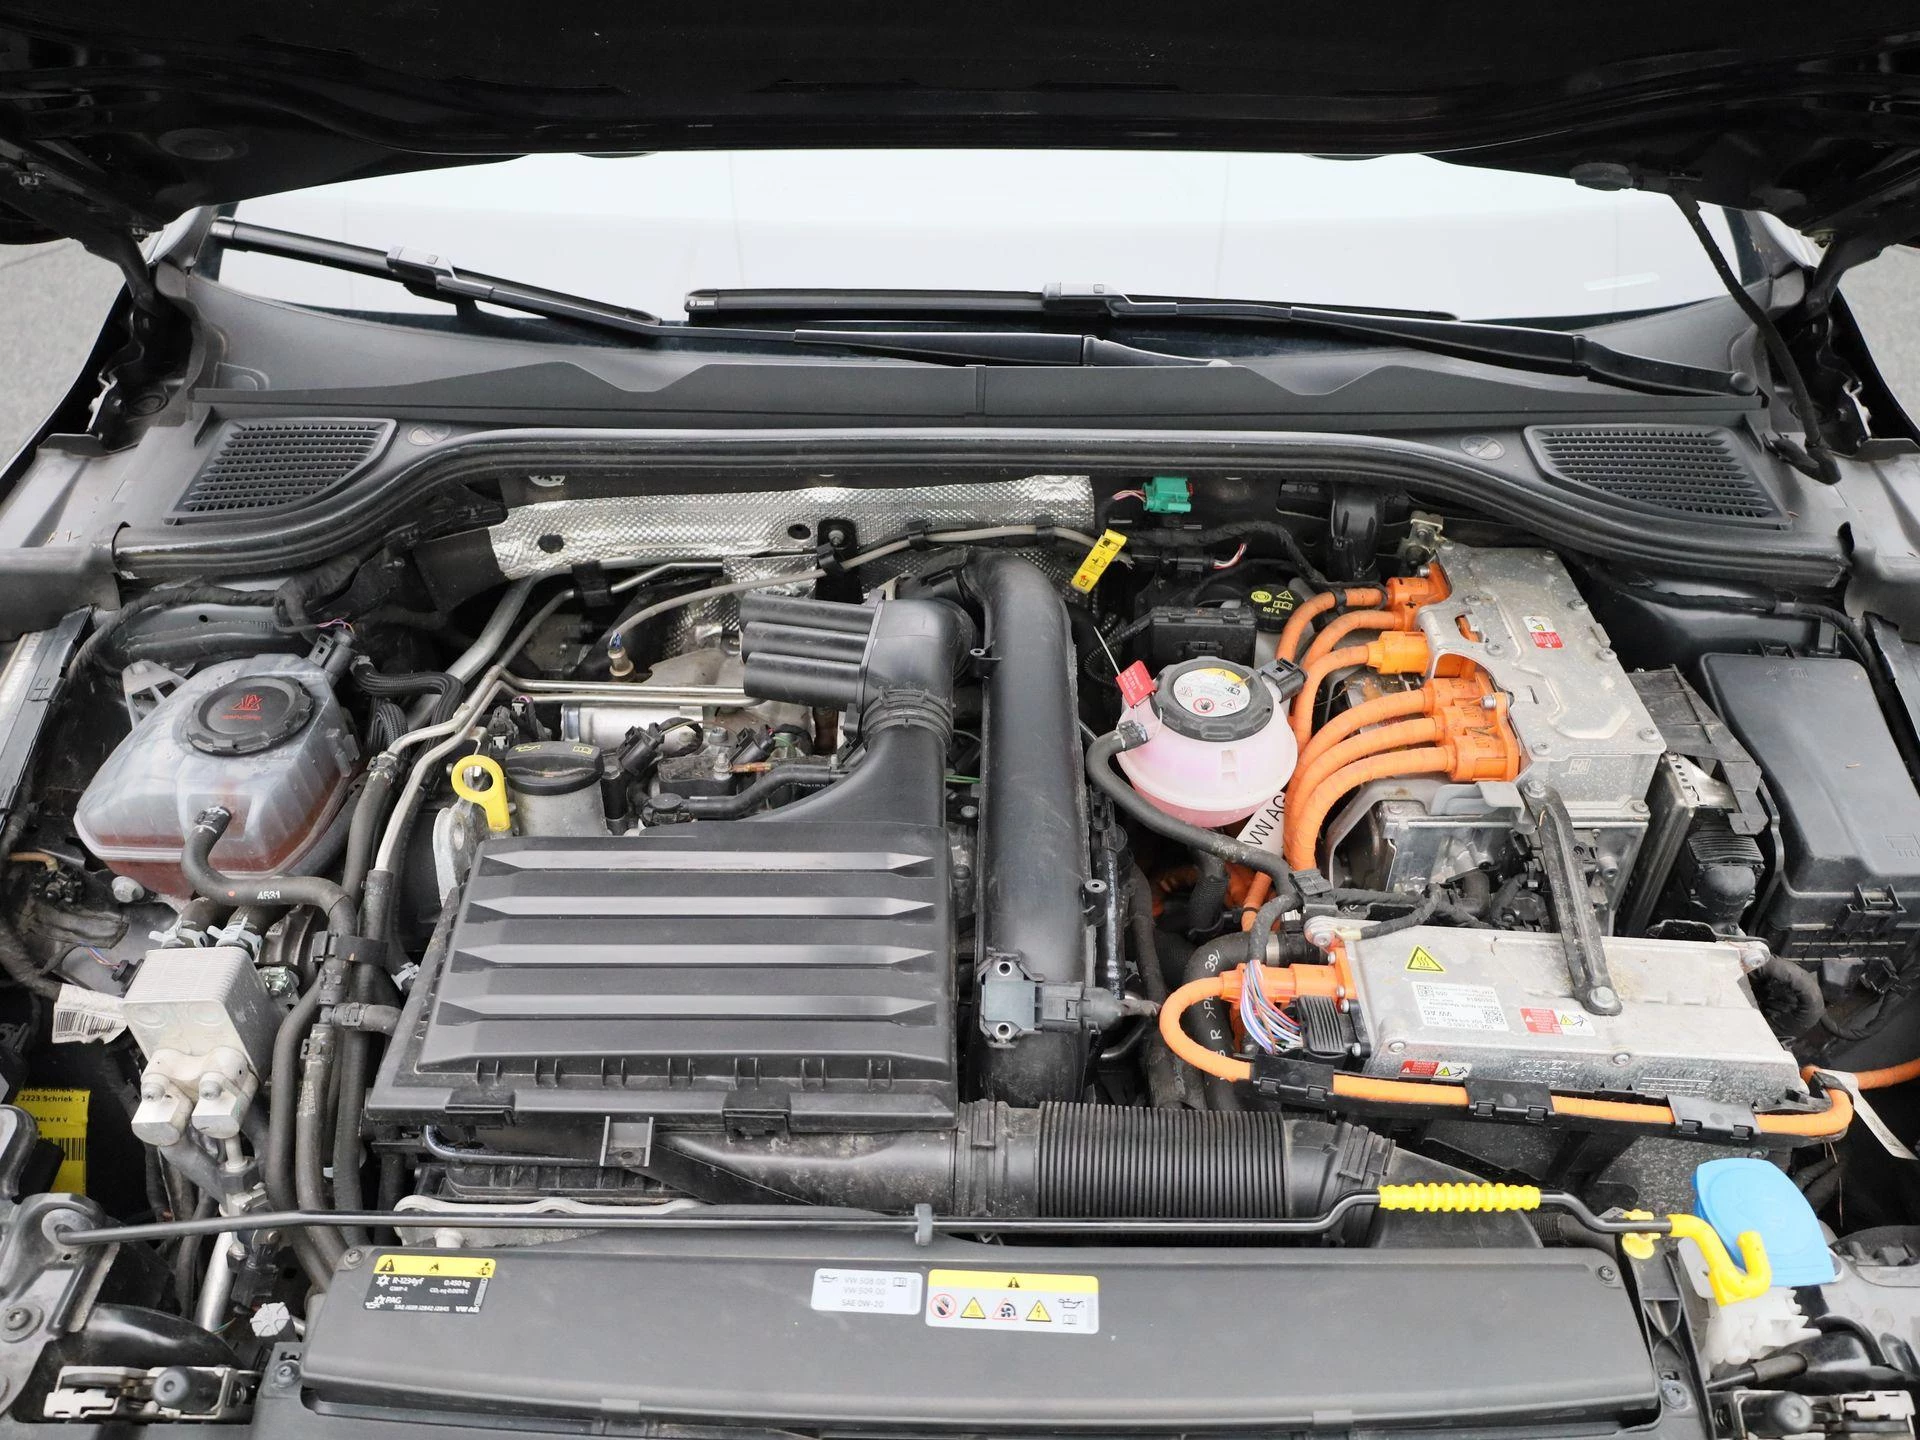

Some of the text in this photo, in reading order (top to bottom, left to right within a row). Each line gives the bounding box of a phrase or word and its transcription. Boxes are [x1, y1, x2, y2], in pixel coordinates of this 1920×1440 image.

[1243, 795, 1286, 846] VW AG
[842, 1286, 856, 1294] VW
[385, 1296, 402, 1304] PAG
[842, 1298, 856, 1306] SAE
